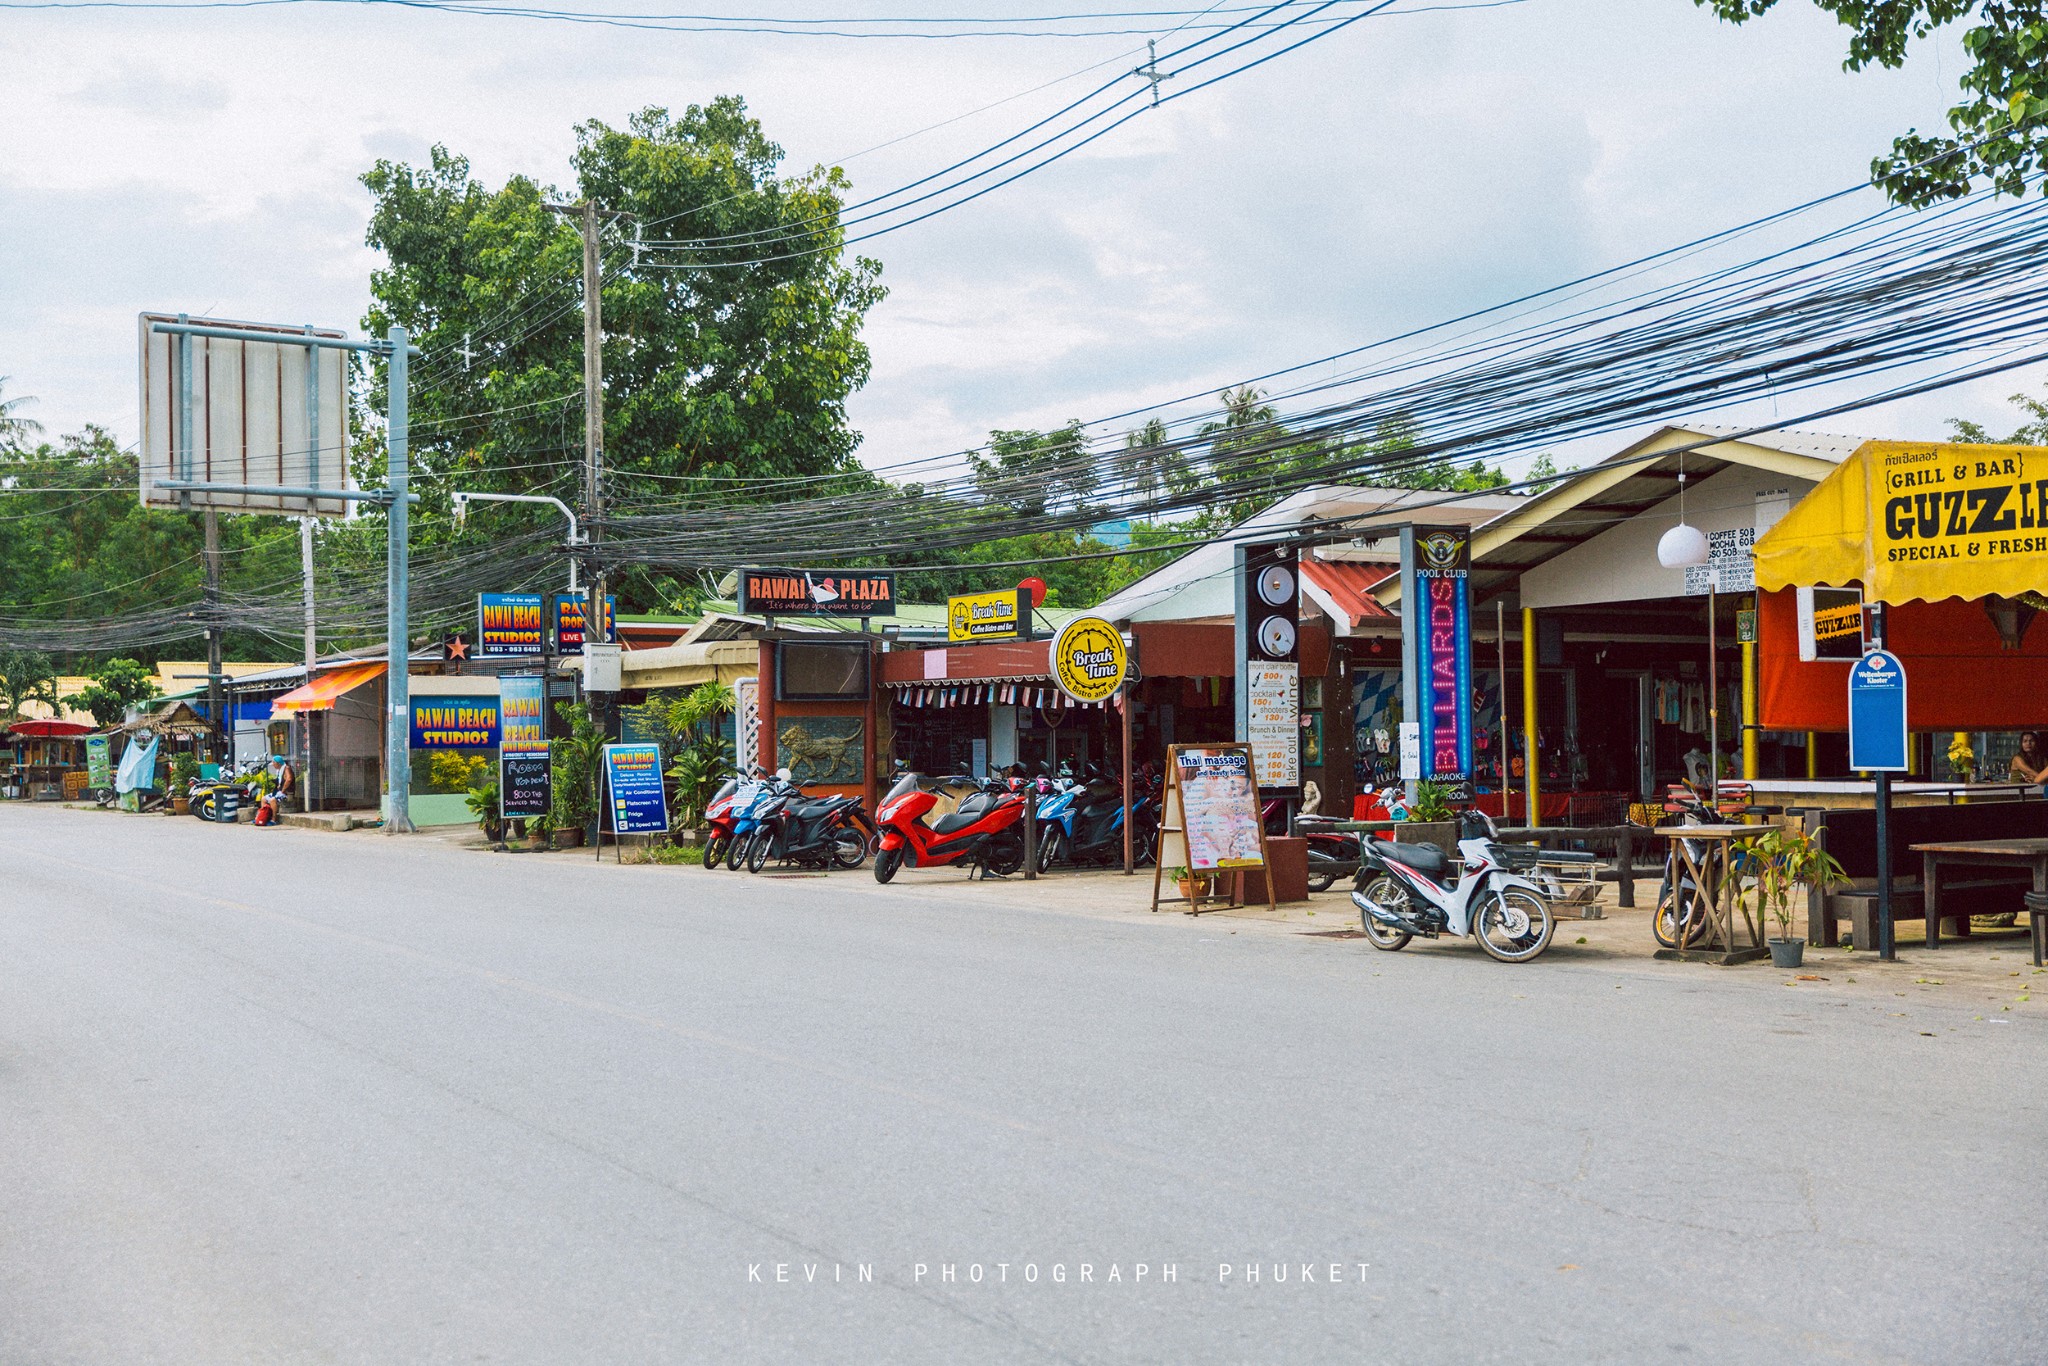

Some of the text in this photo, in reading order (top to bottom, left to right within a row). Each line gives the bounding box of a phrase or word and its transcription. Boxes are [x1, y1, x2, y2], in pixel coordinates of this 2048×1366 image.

[1953, 465, 1967, 480] &
[1710, 530, 1736, 540] COFFEE
[1710, 540, 1736, 549] MOCHA
[1888, 537, 2047, 562] SPECIAL & FRESH
[1417, 569, 1467, 578] POOL CLUB
[750, 578, 890, 600] RAWAI PLAZA
[785, 601, 809, 610] where
[811, 603, 826, 612] you
[851, 602, 859, 610] to
[973, 600, 1012, 619] Break Time
[484, 605, 540, 628] RAWAI BEACH
[563, 633, 579, 641] LIVE
[971, 626, 984, 634] Coffee
[484, 632, 540, 643] STUDIOS
[1073, 648, 1114, 666] Break
[1085, 663, 1118, 679] Time
[1431, 580, 1458, 769] BILLIARDS
[1059, 662, 1119, 698] Coffee Bistro and Bar
[1250, 690, 1276, 698] cocktail
[1287, 675, 1298, 718] wine
[503, 698, 540, 717] RAWAI
[416, 708, 497, 729] RAWAI BEACH
[423, 731, 489, 744] STUDIOS
[503, 725, 540, 741] BEACH
[1286, 736, 1297, 754] out
[635, 751, 656, 764] BEACH
[1180, 755, 1246, 767] Thai massage
[1267, 751, 1282, 759] 120
[1209, 769, 1228, 777] Beauty
[1286, 758, 1297, 781] take
[1428, 772, 1467, 781] KARAOKE
[513, 790, 531, 799] 800
